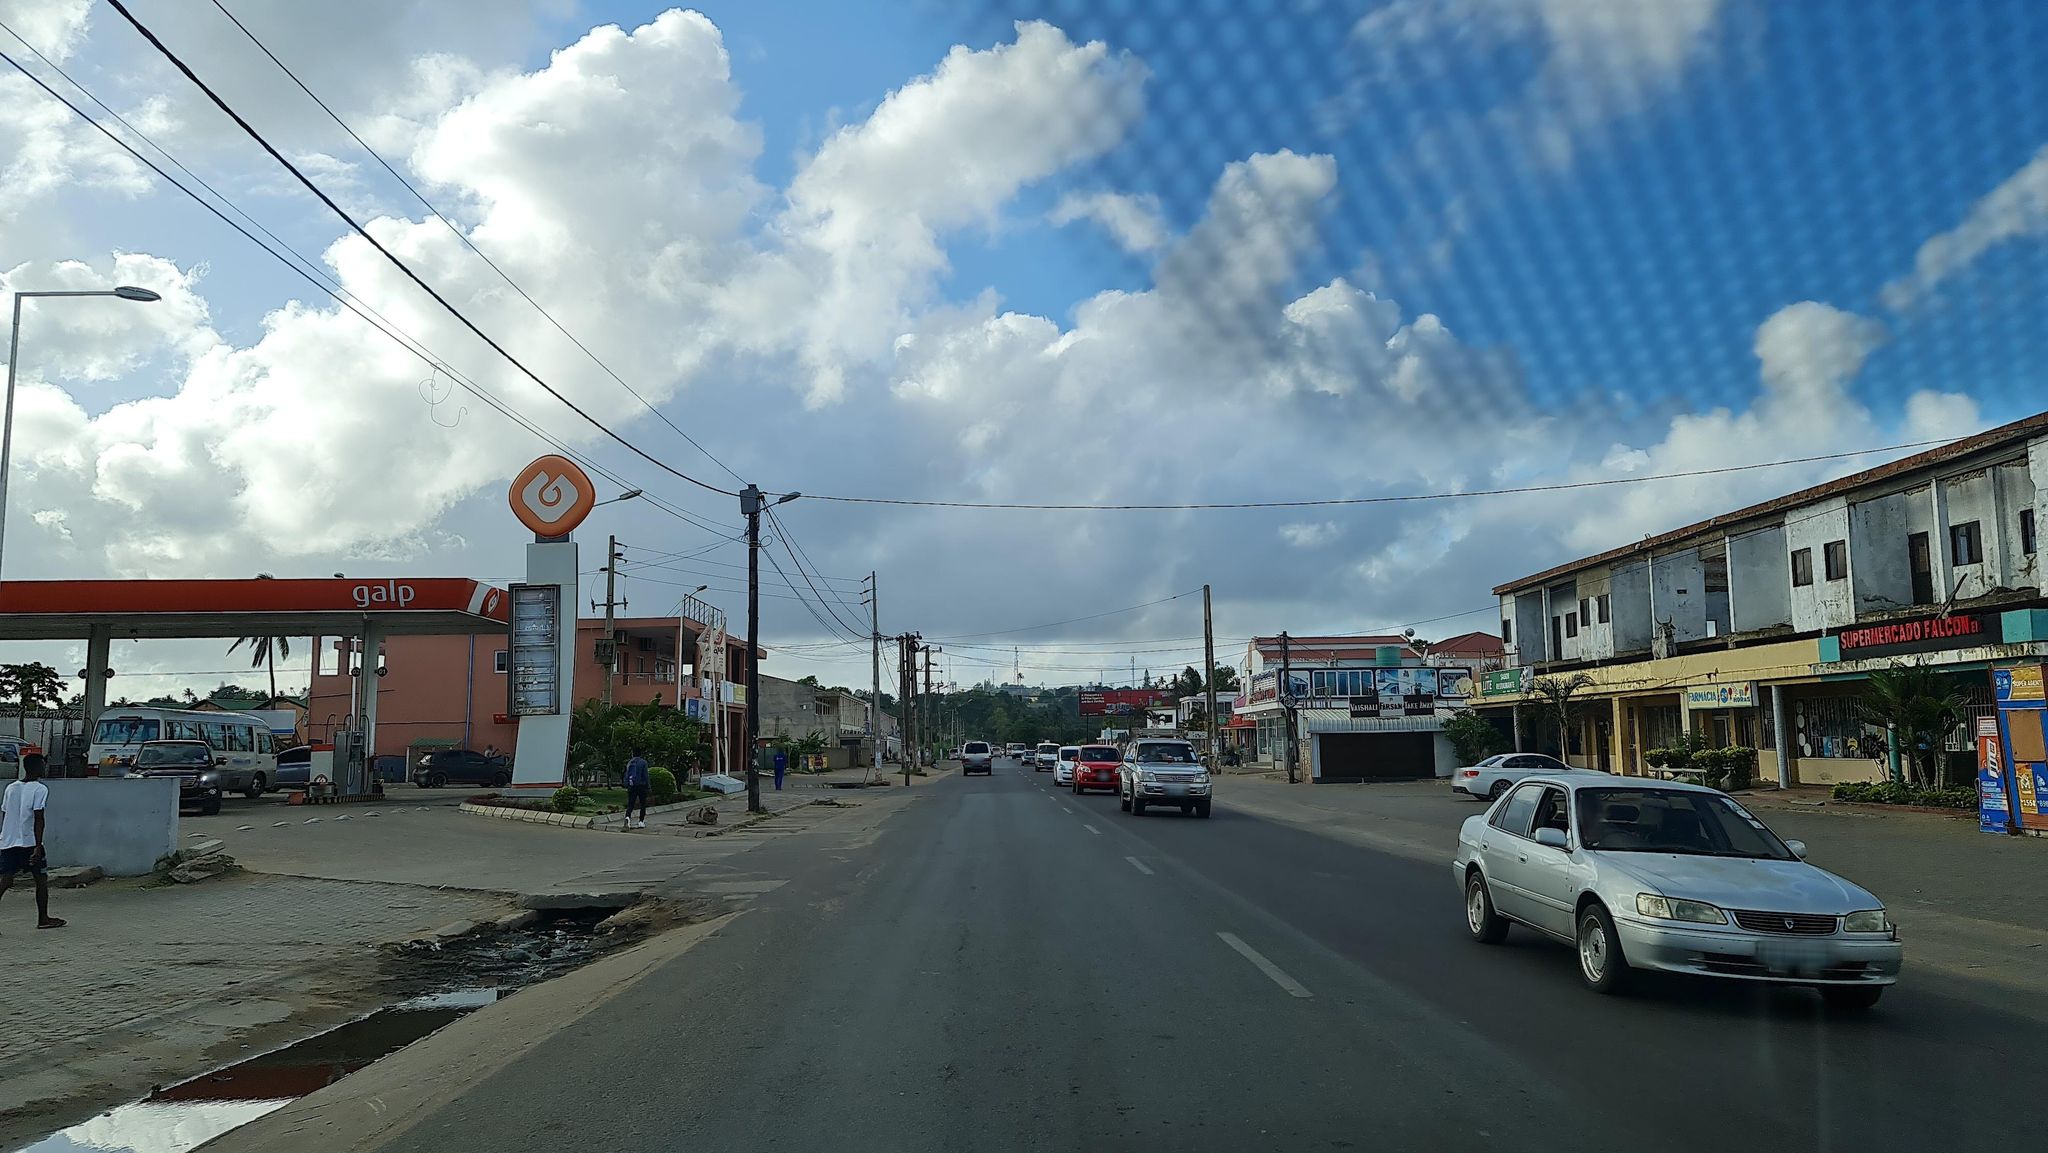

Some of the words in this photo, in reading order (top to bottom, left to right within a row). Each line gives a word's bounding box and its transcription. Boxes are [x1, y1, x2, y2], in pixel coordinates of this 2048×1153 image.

[352, 579, 415, 608] galp
[1840, 621, 1920, 649] SUPERMERCADO
[1924, 615, 1969, 639] FALCON
[1404, 701, 1418, 709] TAKE
